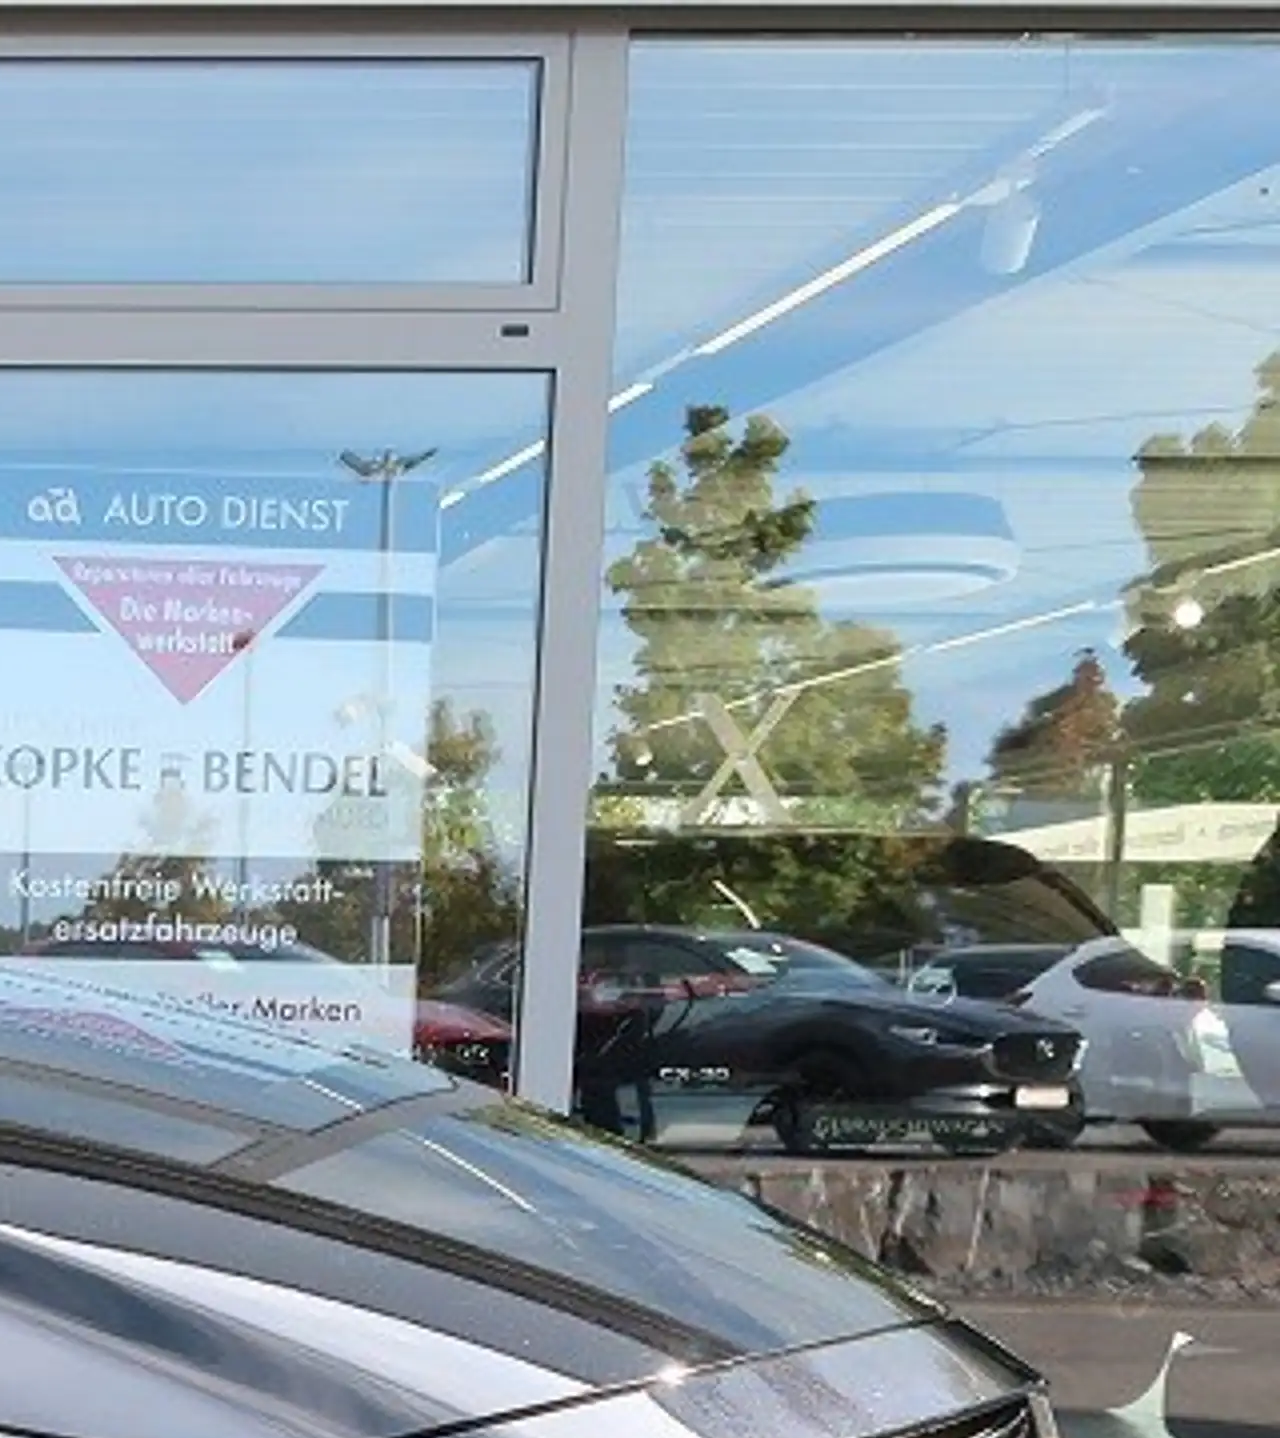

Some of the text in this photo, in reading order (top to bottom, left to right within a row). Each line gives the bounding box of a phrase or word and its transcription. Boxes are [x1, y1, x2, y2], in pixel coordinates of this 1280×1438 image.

[104, 494, 208, 527] AUTO
[223, 499, 350, 533] DIENST
[119, 595, 158, 622] Die
[203, 750, 388, 798] BENDEL
[7, 869, 346, 906] Kostenfreie Werkstatt-
[52, 912, 298, 951] ersatzfahrzeuge
[251, 996, 363, 1021] Marken
